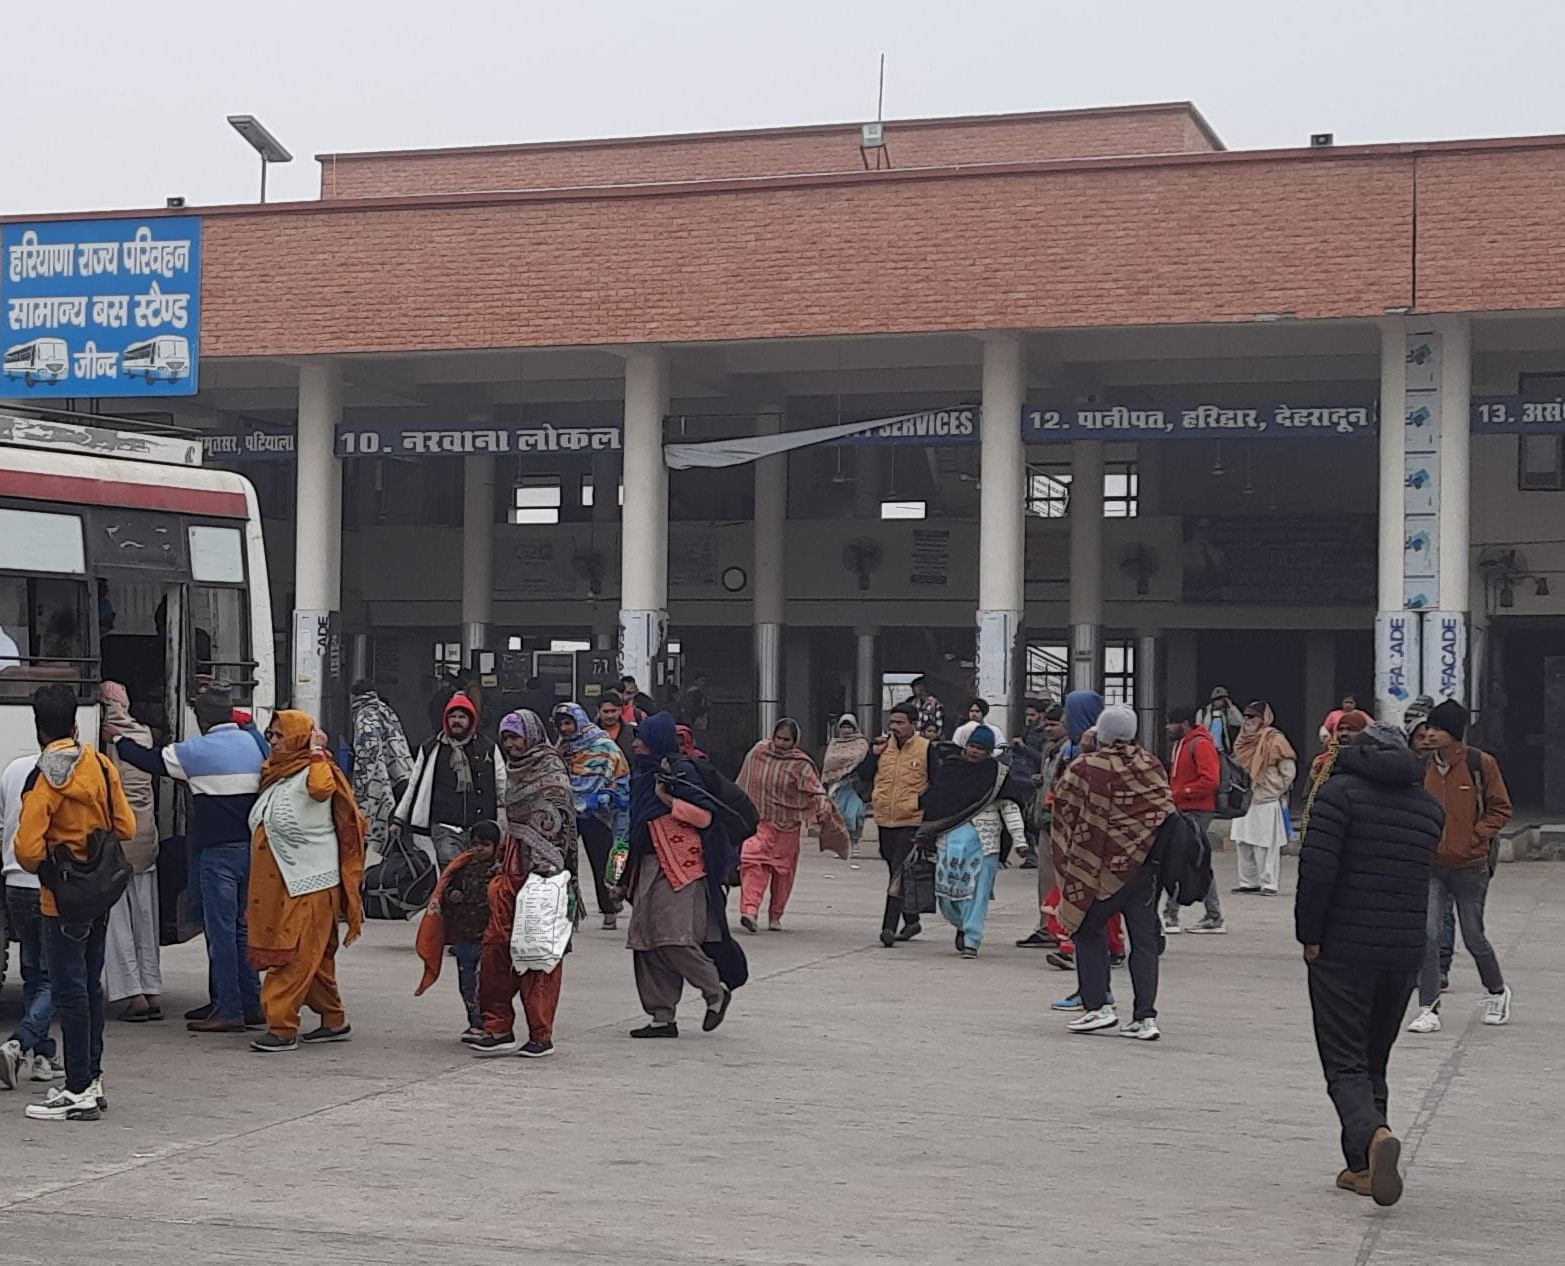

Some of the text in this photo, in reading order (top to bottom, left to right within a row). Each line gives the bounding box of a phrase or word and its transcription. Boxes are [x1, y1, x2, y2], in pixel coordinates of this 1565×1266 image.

[9, 226, 191, 282] हरियाणा राज्य परिवहन
[8, 296, 88, 330] सामान्य
[92, 295, 130, 328] बस
[73, 340, 119, 379] जीन्द
[1029, 411, 1070, 429] 12.
[1478, 397, 1565, 423] 13. असं
[195, 436, 242, 456] मृतसर,
[340, 423, 622, 453] 10. नरवाना लोकल
[1441, 618, 1457, 687] FACADE
